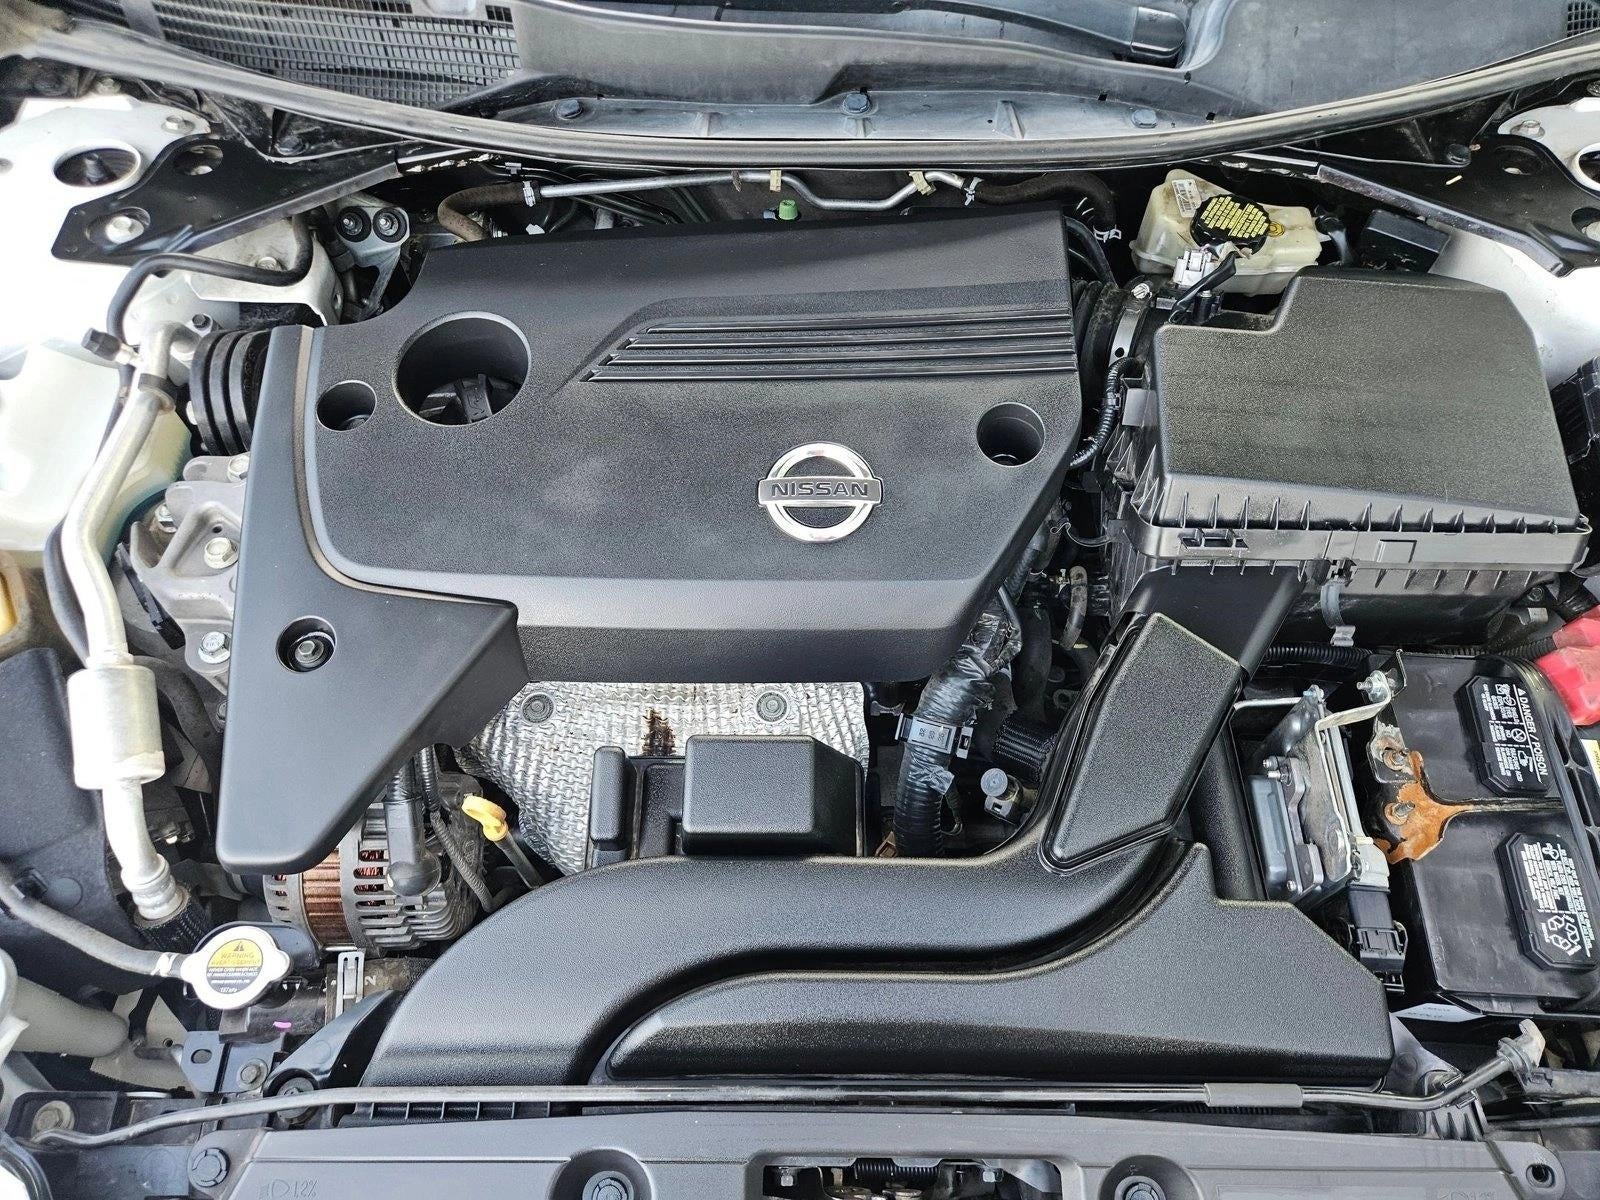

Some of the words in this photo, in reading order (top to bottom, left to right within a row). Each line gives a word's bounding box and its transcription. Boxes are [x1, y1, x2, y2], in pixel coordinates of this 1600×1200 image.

[771, 482, 868, 497] NISSAN
[1504, 729, 1511, 737] NO
[1519, 697, 1536, 733] DANGER
[1531, 741, 1548, 775] POISON
